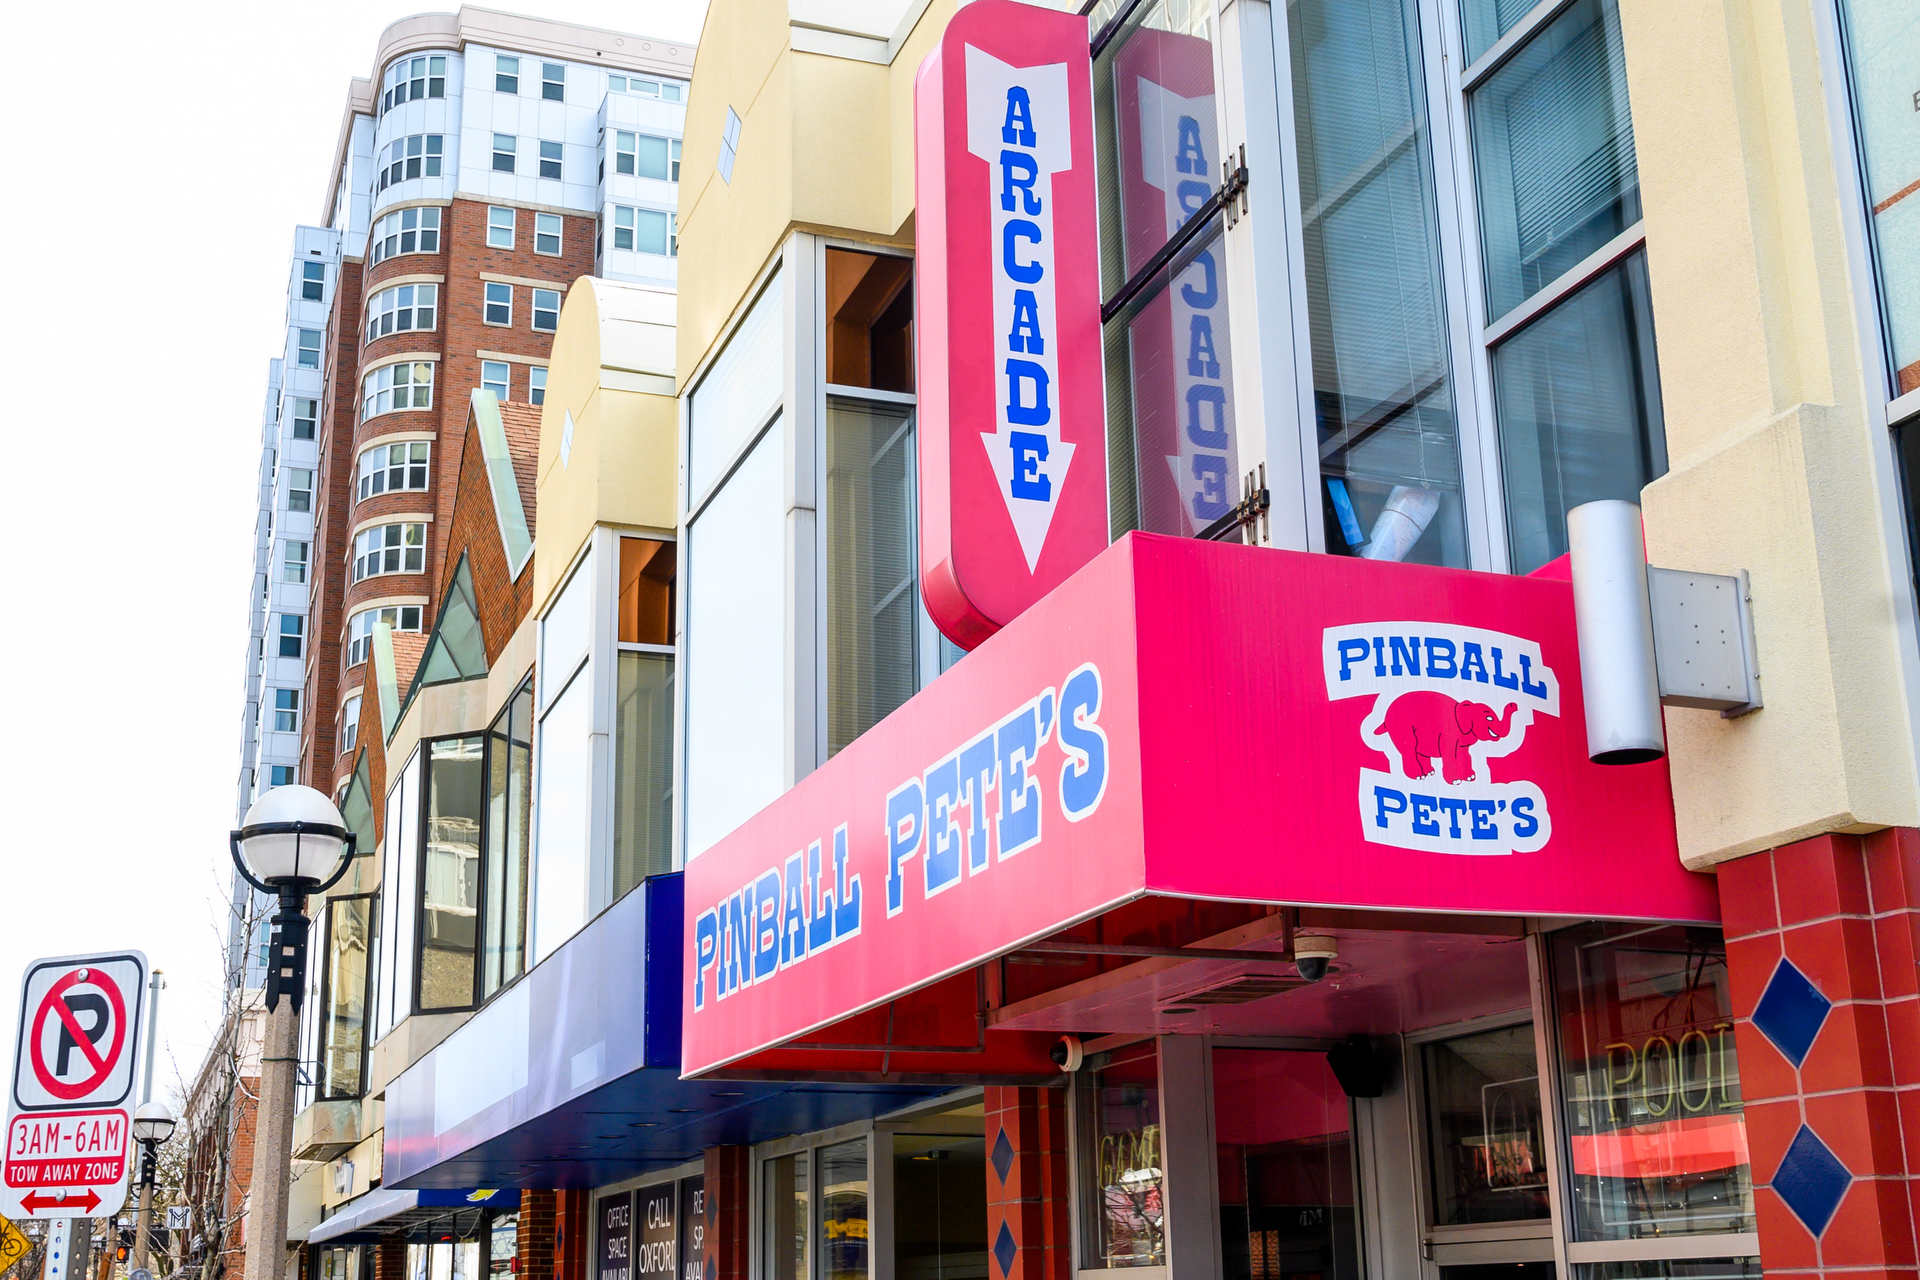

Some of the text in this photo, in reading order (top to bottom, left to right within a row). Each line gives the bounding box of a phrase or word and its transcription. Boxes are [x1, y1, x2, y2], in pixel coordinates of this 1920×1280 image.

[1000, 86, 1052, 502] ARCADE
[1337, 636, 1548, 700] PINBALL
[1374, 785, 1539, 840] PETE'S
[694, 662, 1108, 1013] PINBALL PETE'S
[1605, 1023, 1744, 1122] POOL
[16, 1119, 121, 1155] 3AM-6AM
[10, 1162, 119, 1183] TOW AWAY ZONE
[607, 1205, 629, 1230] OFFICE
[648, 1197, 671, 1230] CALL
[608, 1237, 628, 1260] SPACE
[693, 1225, 704, 1250] SP
